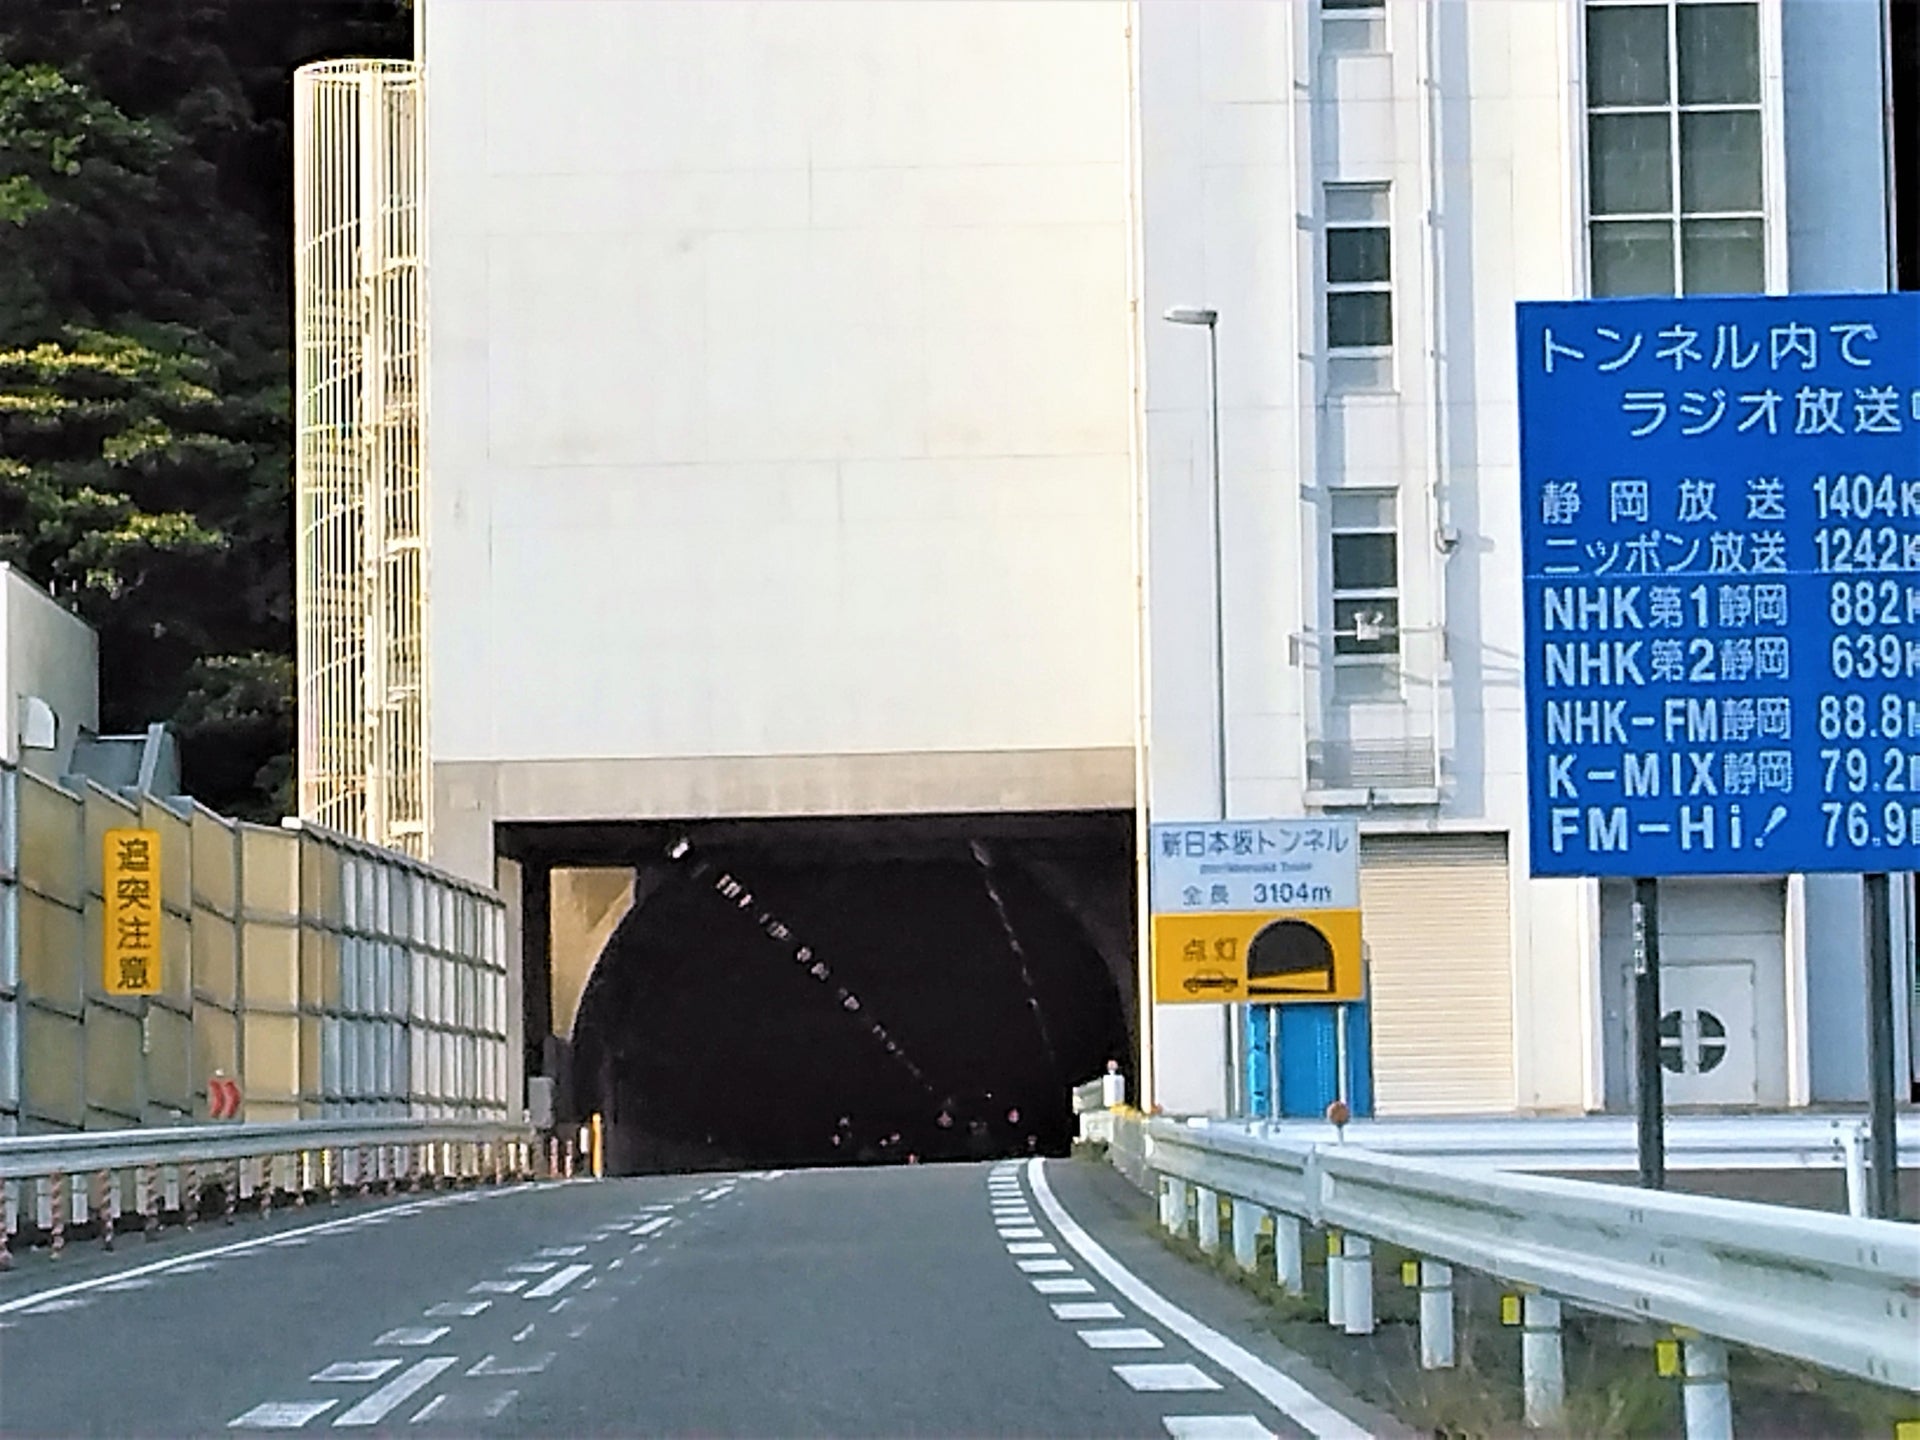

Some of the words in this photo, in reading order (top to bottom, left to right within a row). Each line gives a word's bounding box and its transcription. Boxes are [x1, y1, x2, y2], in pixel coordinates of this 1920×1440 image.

[1546, 323, 1876, 372] トンネル内で
[1624, 386, 1920, 435] ラジオ放送
[1546, 531, 1786, 572] ニッポン放送
[1545, 585, 1786, 630] NHK第1静岡
[1546, 638, 1788, 685] NHK第2静岡
[1162, 829, 1349, 856] 新日本坂トンネル
[117, 838, 150, 989] 追突注意
[1254, 882, 1332, 903] 3104m
